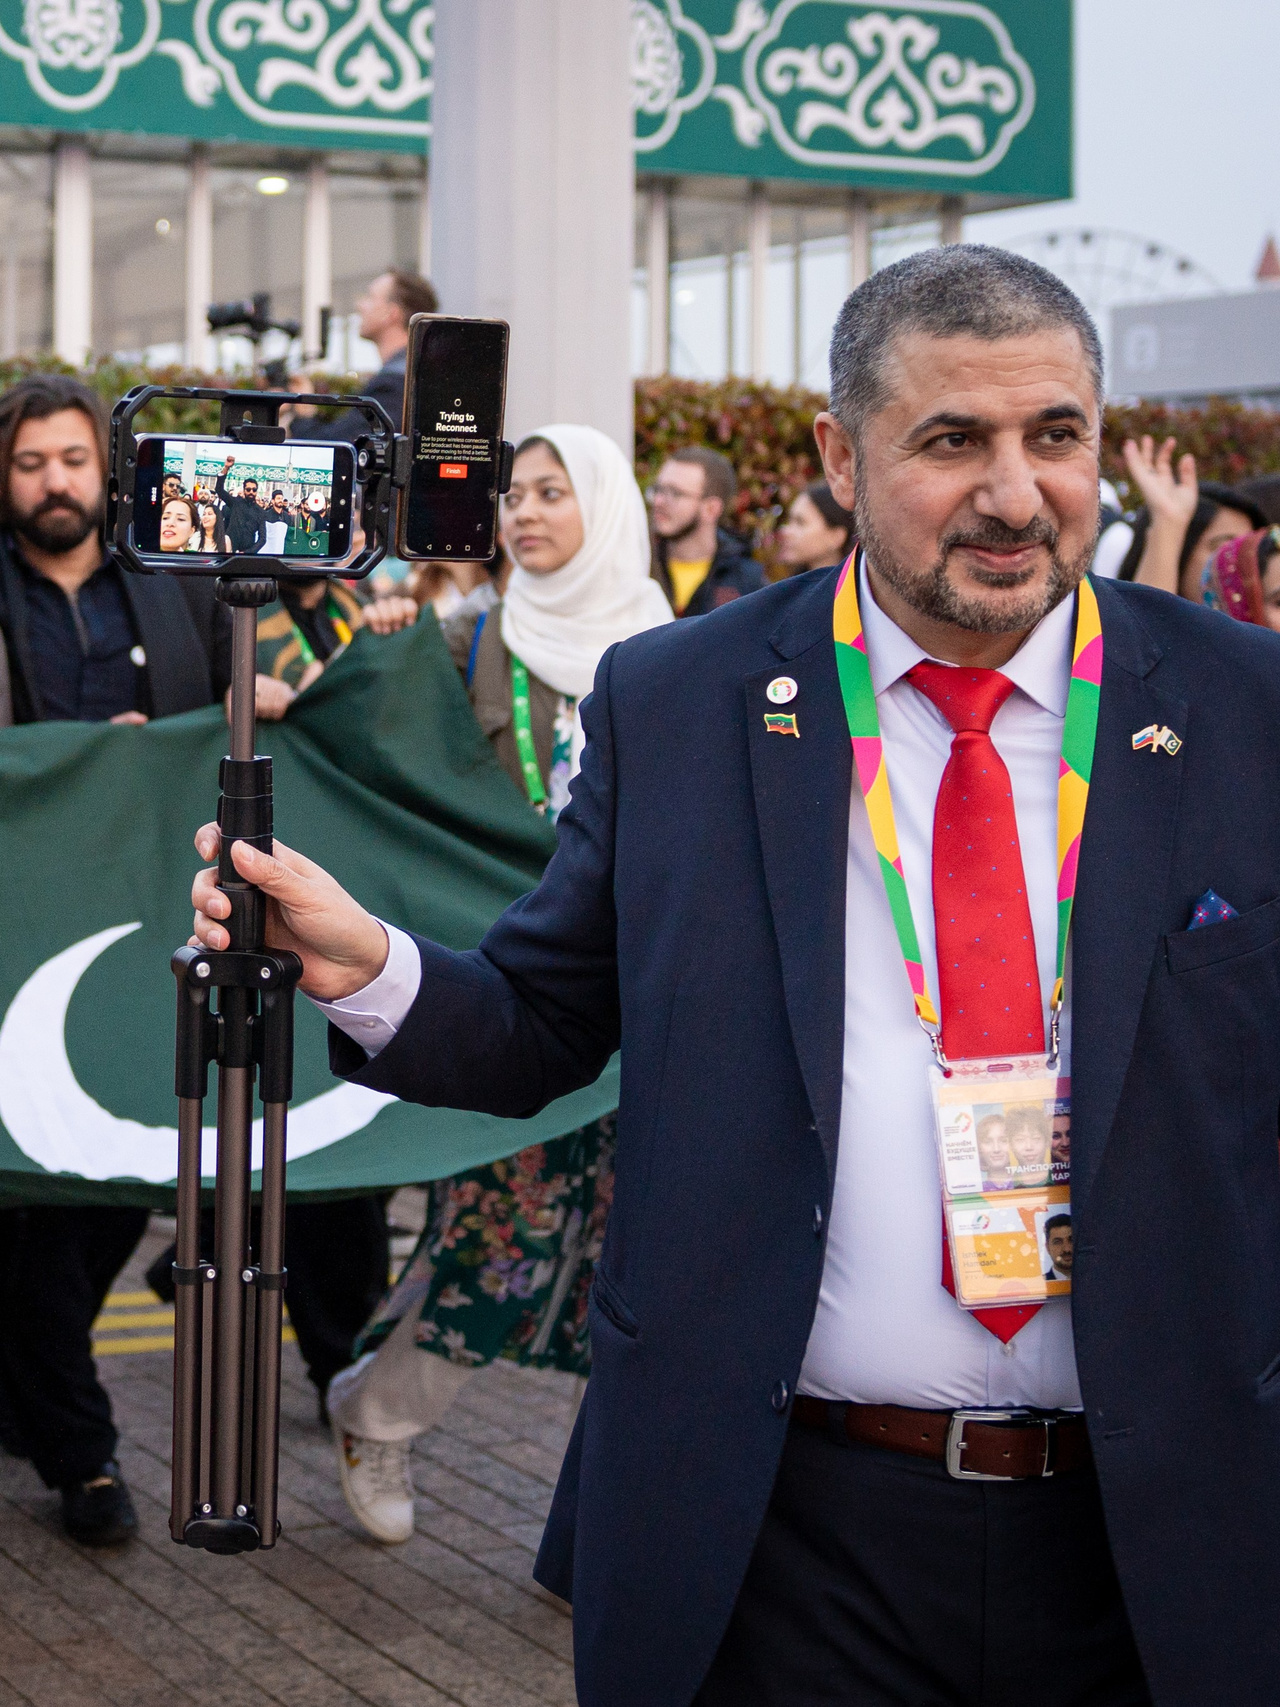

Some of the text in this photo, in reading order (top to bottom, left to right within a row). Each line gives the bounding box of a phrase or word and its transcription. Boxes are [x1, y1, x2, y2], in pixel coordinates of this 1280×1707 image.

[440, 411, 475, 423] Trying to
[436, 423, 477, 432] Reconnect
[963, 1259, 997, 1267] Hamdani
